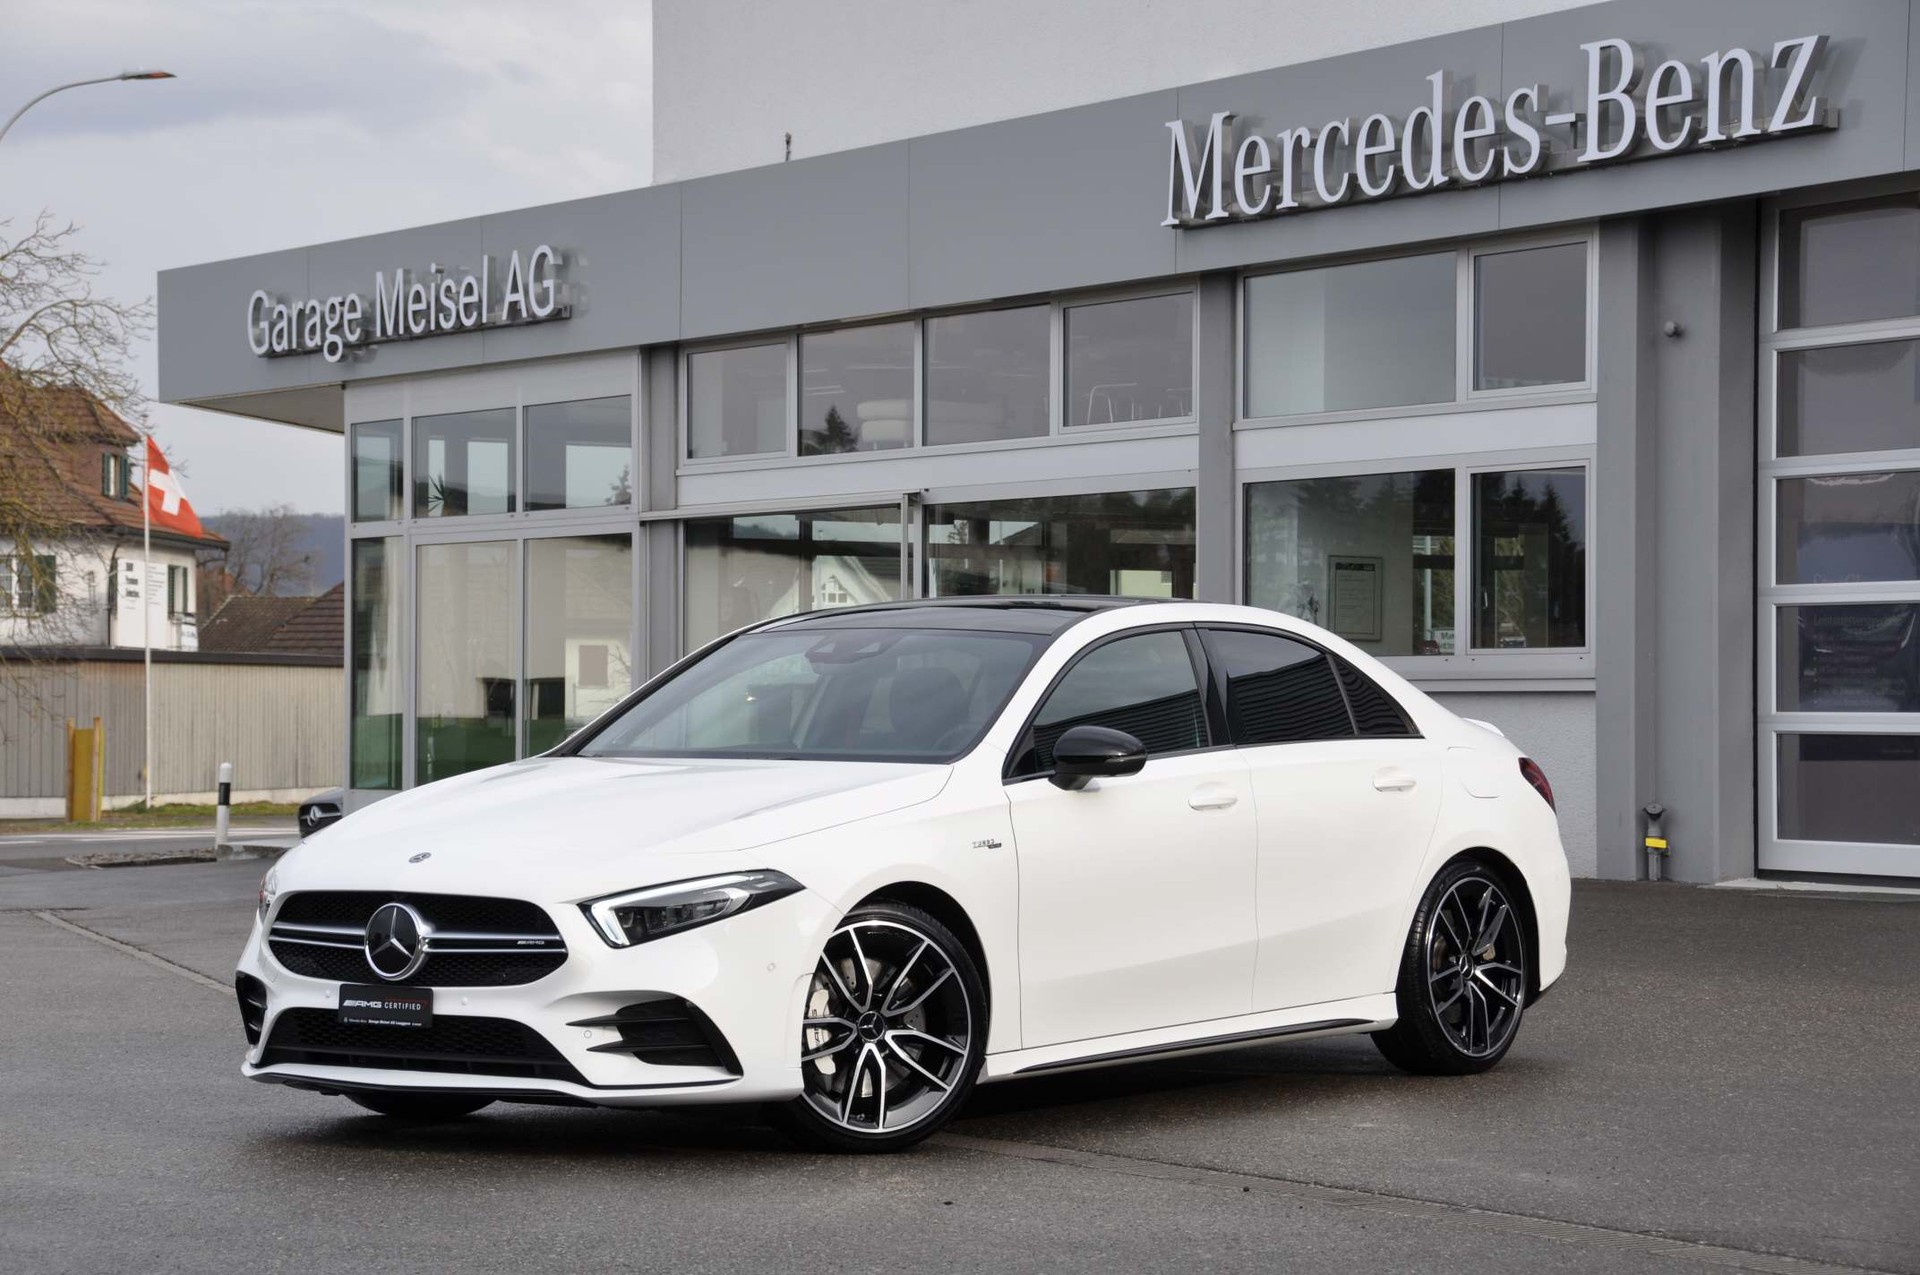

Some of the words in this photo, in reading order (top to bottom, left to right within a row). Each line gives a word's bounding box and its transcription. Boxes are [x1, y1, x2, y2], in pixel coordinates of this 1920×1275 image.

[1161, 34, 1822, 227] Mercedes-Benz
[248, 289, 362, 363] Garage
[375, 254, 489, 337] Meisel
[502, 244, 555, 320] AG
[384, 1002, 421, 1010] CERTIFIED
